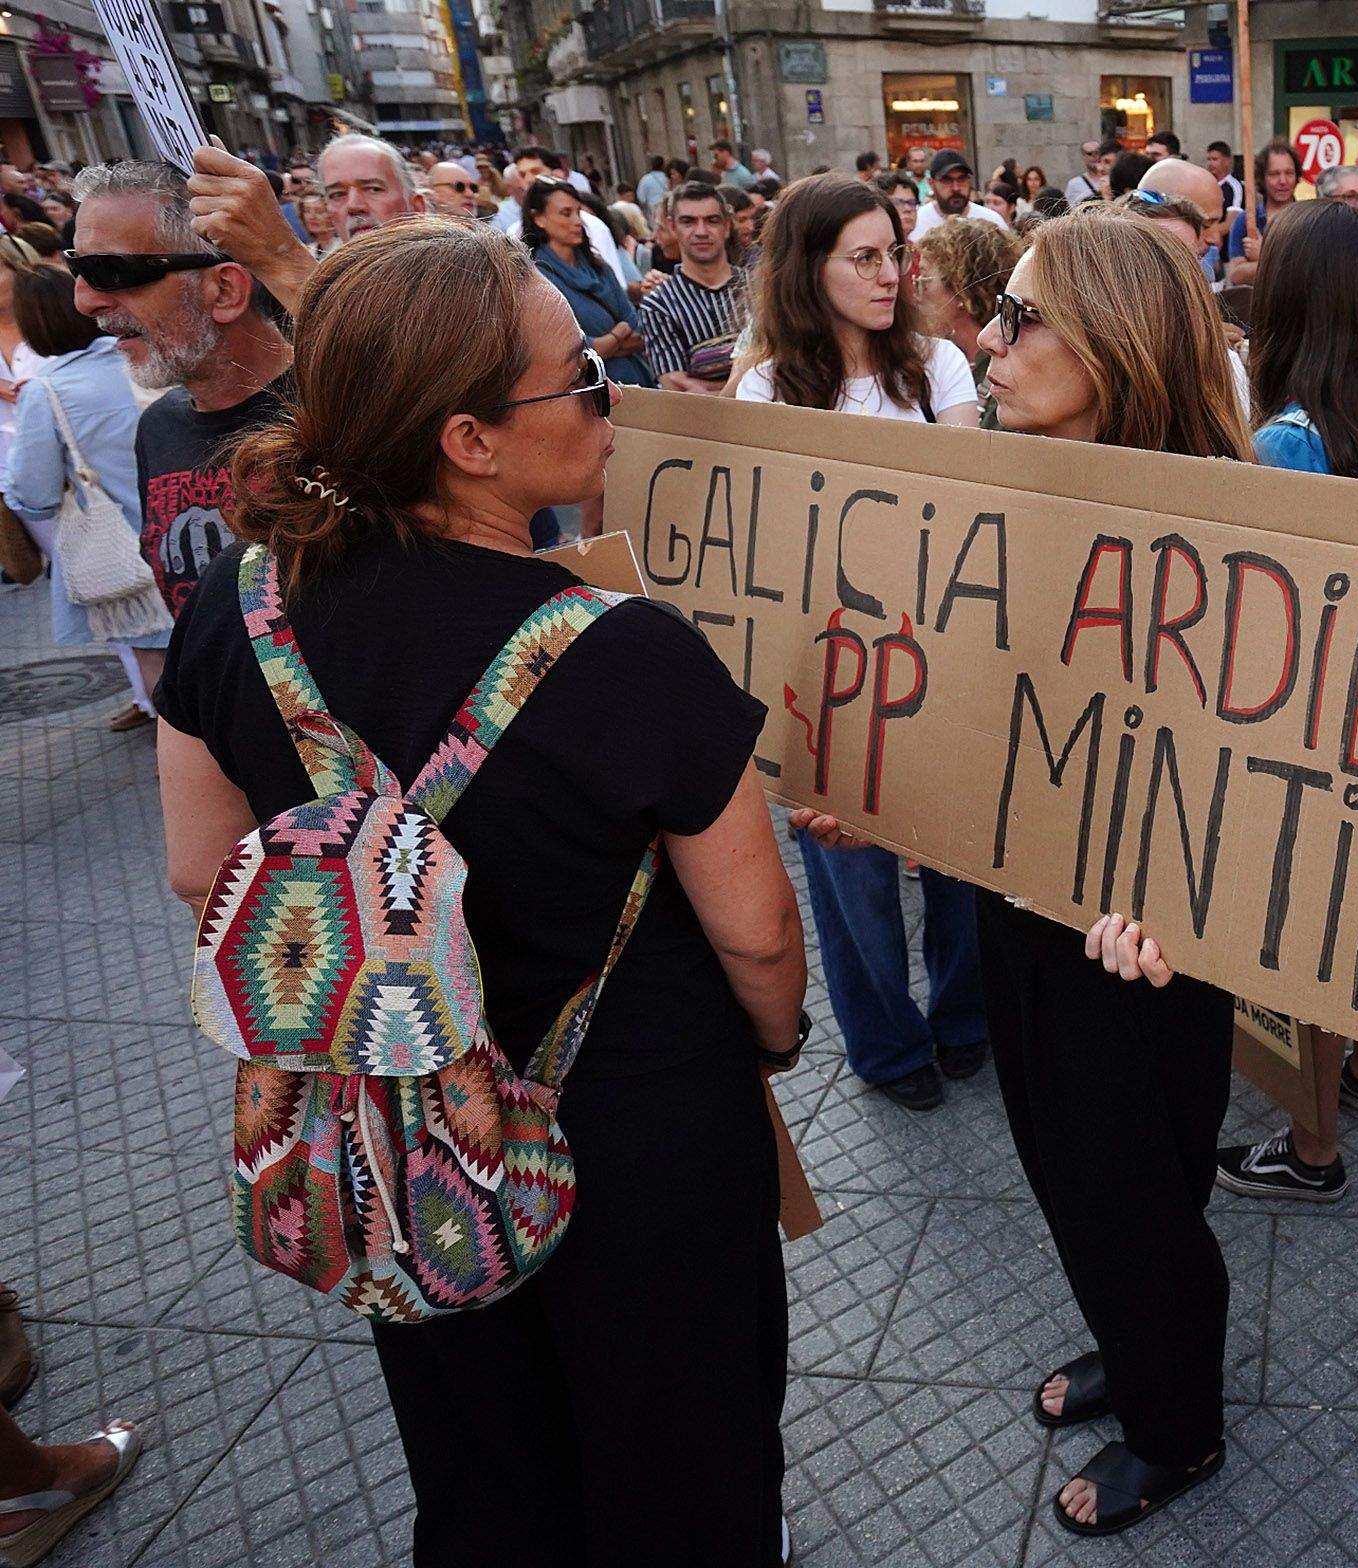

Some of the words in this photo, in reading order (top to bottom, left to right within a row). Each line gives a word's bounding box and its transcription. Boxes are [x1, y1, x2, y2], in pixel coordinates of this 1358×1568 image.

[140, 54, 172, 110] PP
[1299, 133, 1342, 171] 70
[814, 610, 928, 816] PP
[1251, 1005, 1293, 1049] MORRE
